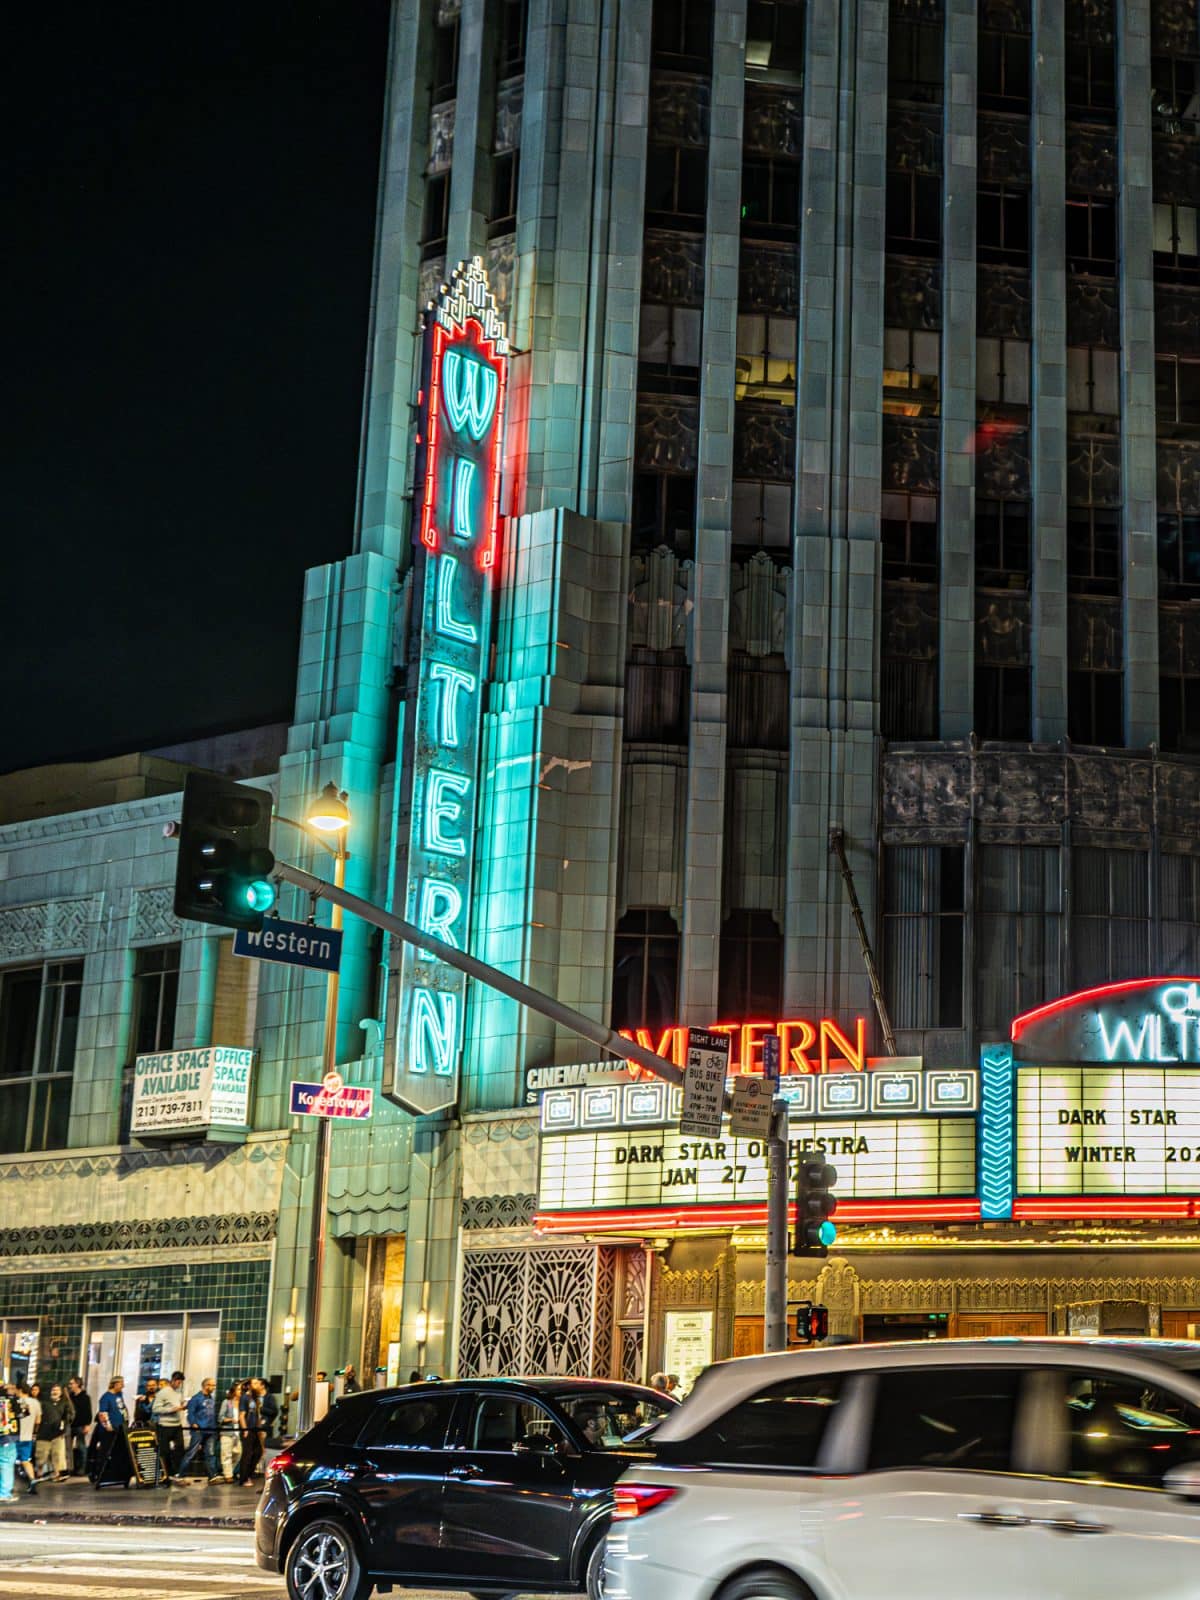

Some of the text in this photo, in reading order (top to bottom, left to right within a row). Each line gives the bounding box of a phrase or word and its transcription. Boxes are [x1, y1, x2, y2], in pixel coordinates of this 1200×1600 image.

[408, 350, 498, 1077] WILTERN
[247, 930, 331, 960] Western
[617, 1018, 866, 1080] WITERN
[690, 1033, 728, 1048] RIGHT LANE
[136, 1050, 211, 1076] OFFICE SPACE
[214, 1049, 250, 1066] OFFICE
[215, 1066, 247, 1082] SPACE
[689, 1068, 722, 1082] BUS BIKE
[141, 1072, 201, 1096] AVAILABLE
[694, 1081, 715, 1092] ONLY
[135, 1104, 157, 1117] (213)
[160, 1100, 202, 1115] 739-7811
[1058, 1109, 1107, 1126] DARK
[1130, 1109, 1177, 1126] STAR
[615, 1135, 870, 1164] DARK STAR OHESTRA
[1065, 1146, 1136, 1163] WINTER
[661, 1167, 697, 1187] JAN
[721, 1165, 747, 1184] 27
